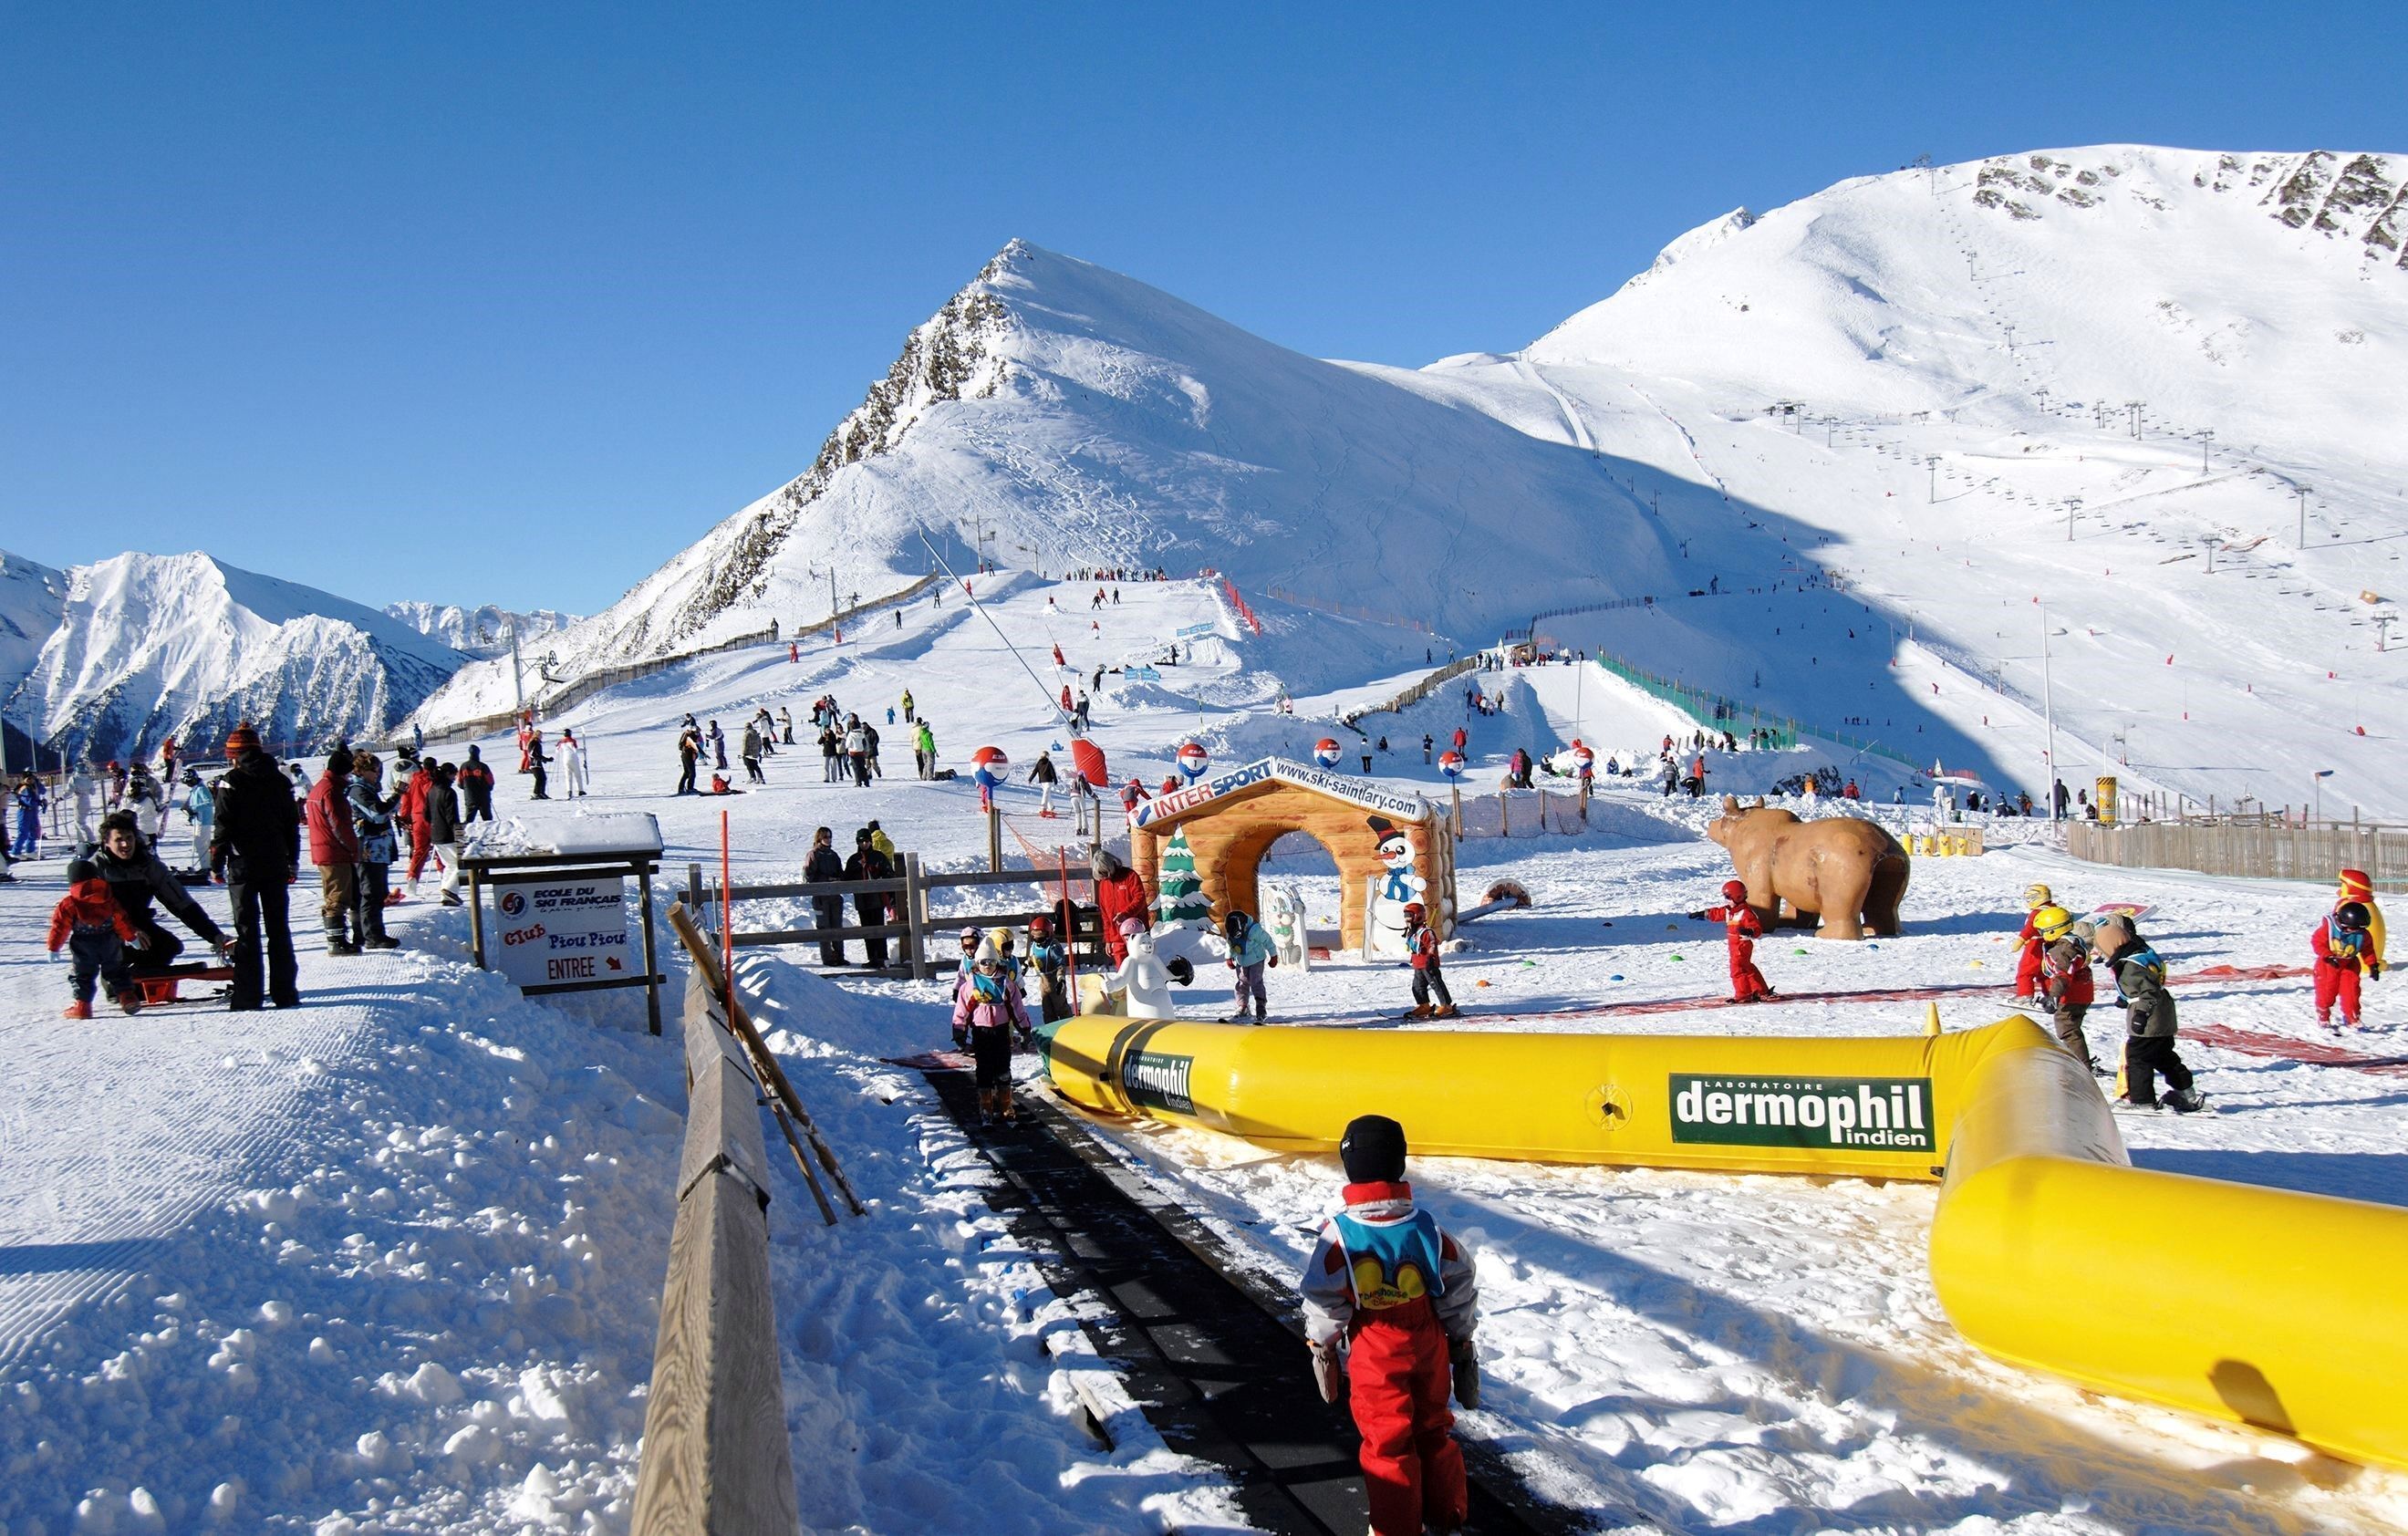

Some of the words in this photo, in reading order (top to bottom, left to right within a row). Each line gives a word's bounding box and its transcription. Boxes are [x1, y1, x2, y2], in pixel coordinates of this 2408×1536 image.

[1154, 761, 1271, 818] INTERSPORT
[1277, 763, 1417, 815] www.ski-saintlary.com
[534, 888, 573, 898] ECOLE
[576, 887, 596, 896] DU
[535, 899, 556, 908] SKI
[560, 895, 622, 907] FRANÇAIS
[504, 923, 546, 946] Club
[549, 934, 586, 949] Piou
[589, 932, 626, 946] Piou
[547, 956, 596, 980] ENTREE
[1124, 1054, 1189, 1106] dermophil
[1704, 1080, 1824, 1091] LABORATOIRE
[1168, 1095, 1193, 1111] indien
[1676, 1080, 1925, 1144] dermophil
[1847, 1128, 1926, 1147] indien
